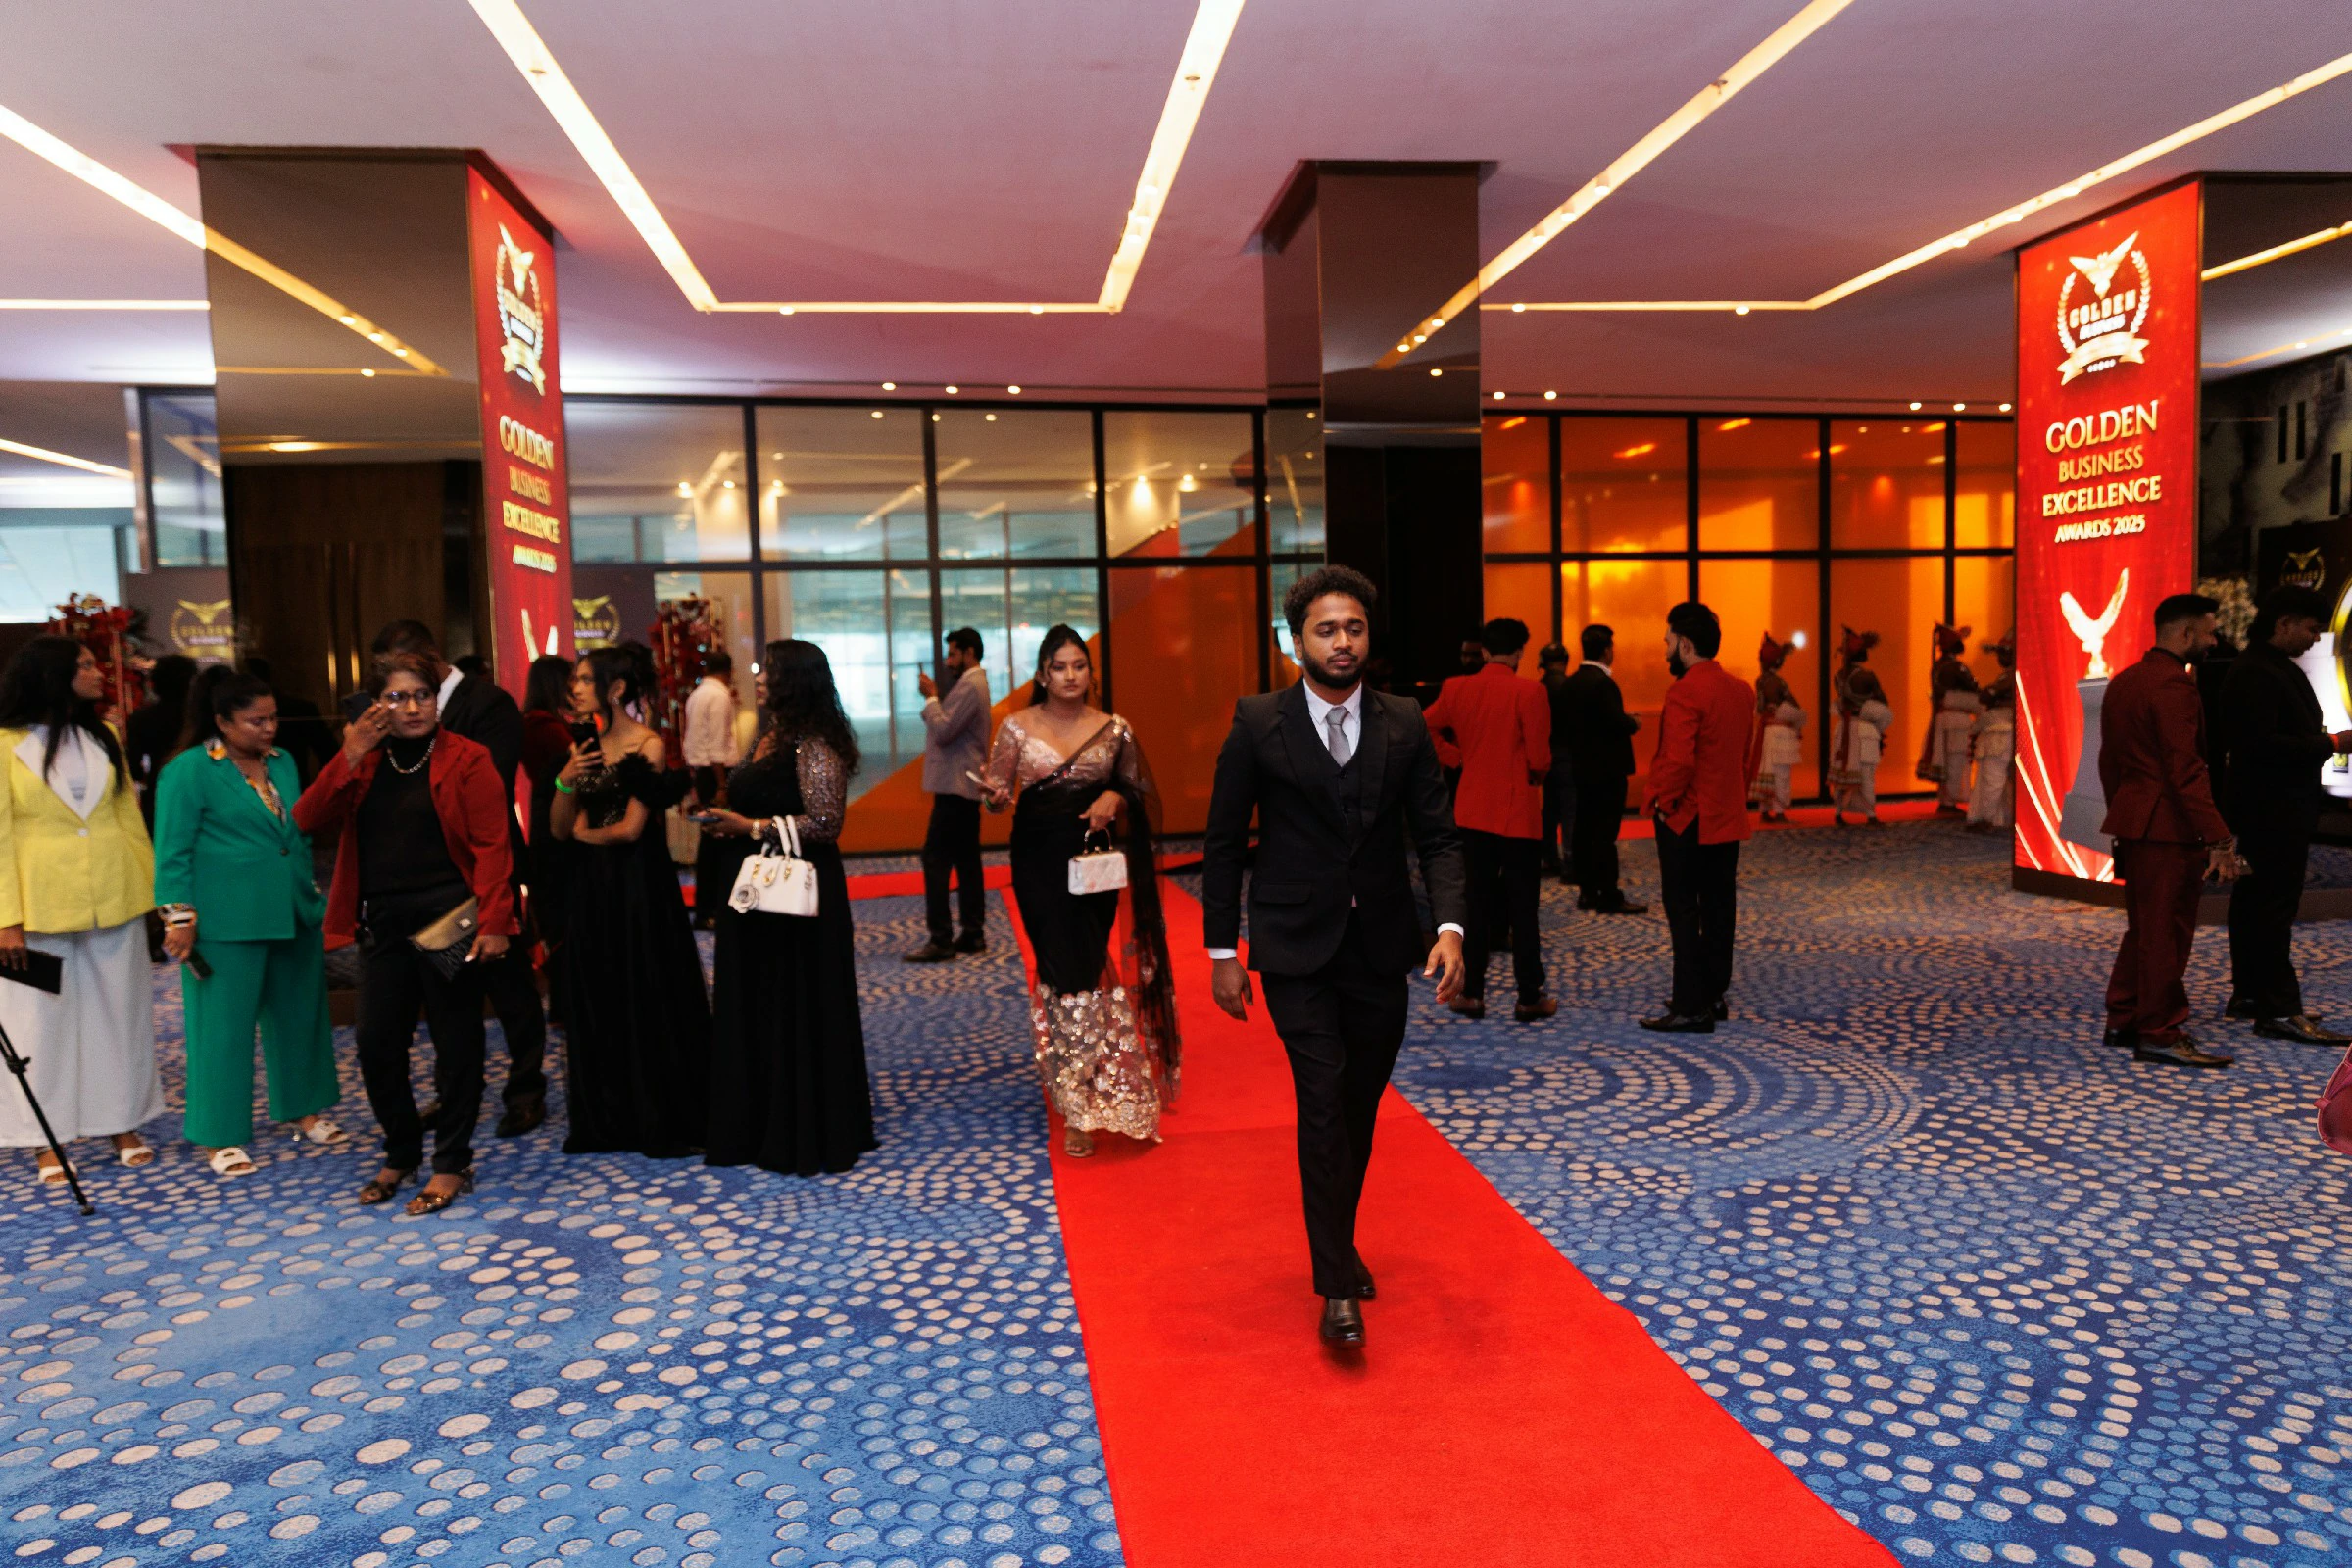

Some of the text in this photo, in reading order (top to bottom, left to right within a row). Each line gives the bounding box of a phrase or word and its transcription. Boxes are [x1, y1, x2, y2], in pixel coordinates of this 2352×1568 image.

[499, 415, 555, 470] GOLDEN
[2045, 399, 2159, 453] GOLDEN
[2058, 444, 2144, 483] BUSINESS
[2042, 475, 2161, 516] EXCELLENCE
[2054, 514, 2146, 543] AWARDS 2025
